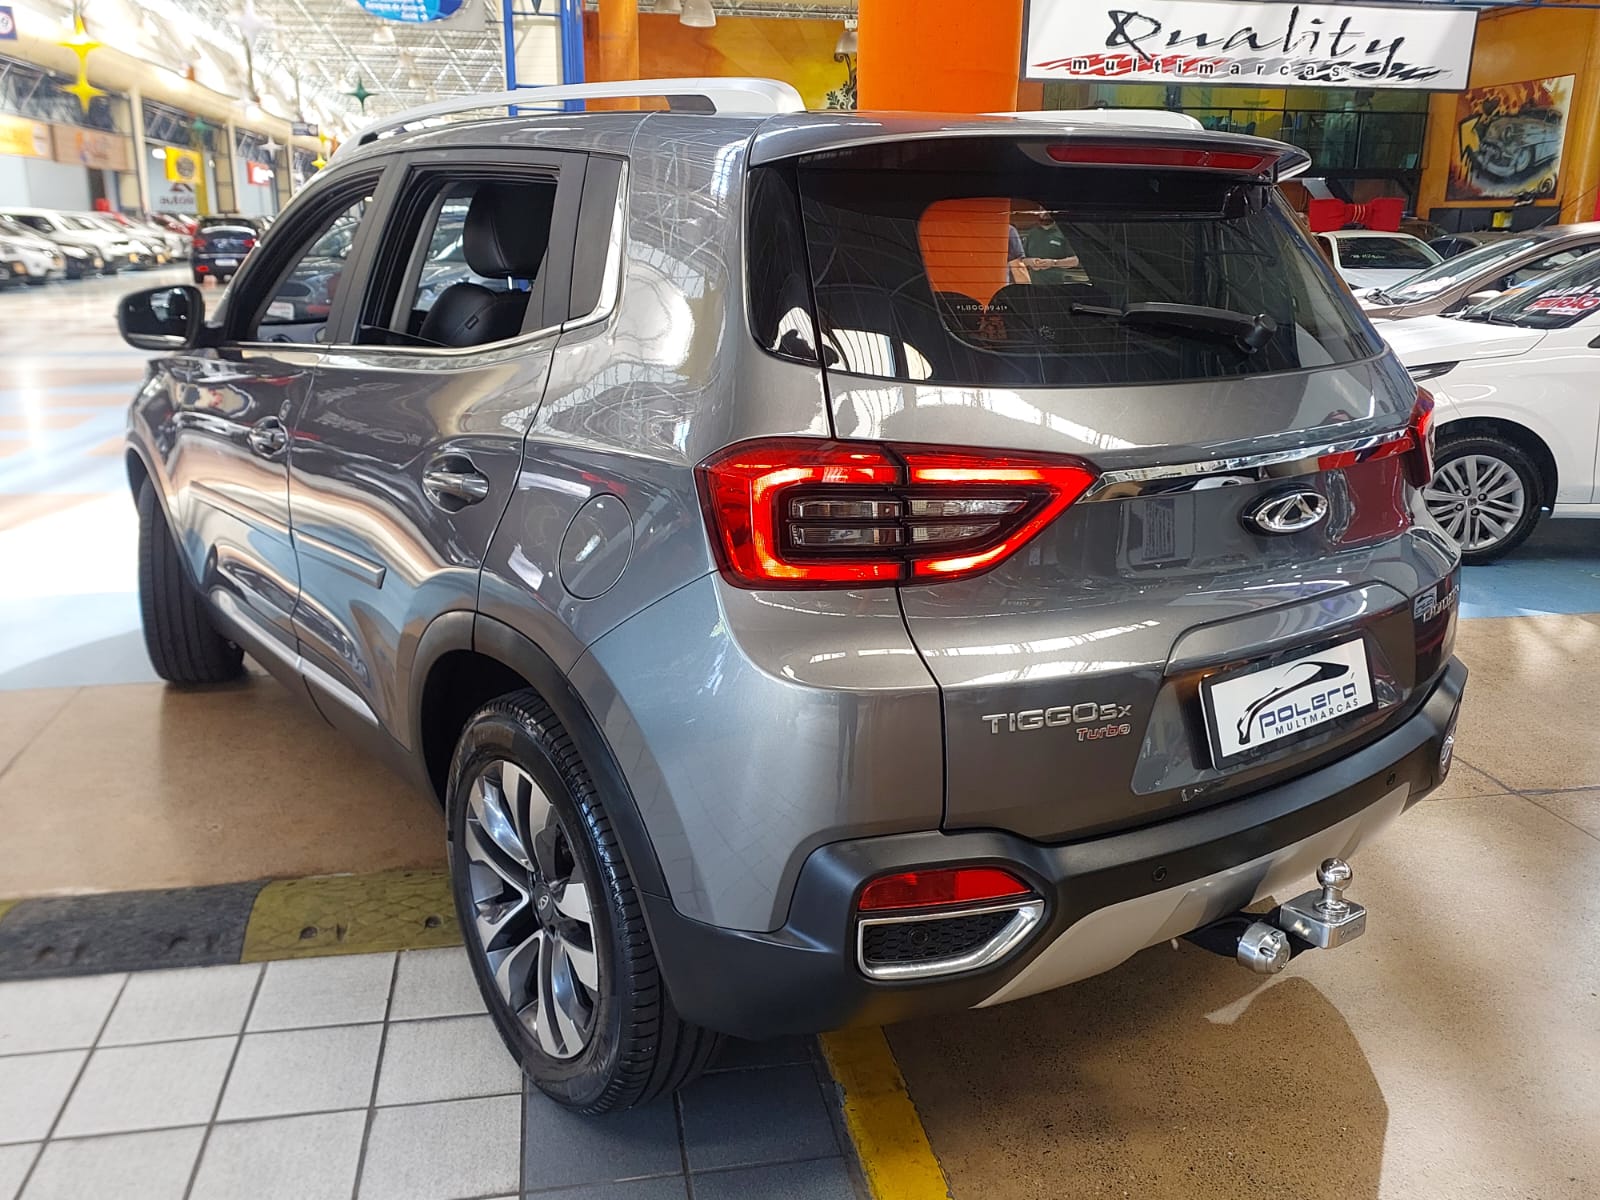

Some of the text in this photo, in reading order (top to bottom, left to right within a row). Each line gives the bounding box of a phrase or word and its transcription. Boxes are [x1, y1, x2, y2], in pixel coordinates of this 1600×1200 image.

[1105, 5, 1407, 78] Quality
[1070, 56, 1340, 79] multimarcas
[1275, 699, 1359, 736] MULTMARCAS
[1076, 724, 1131, 742] Turbo
